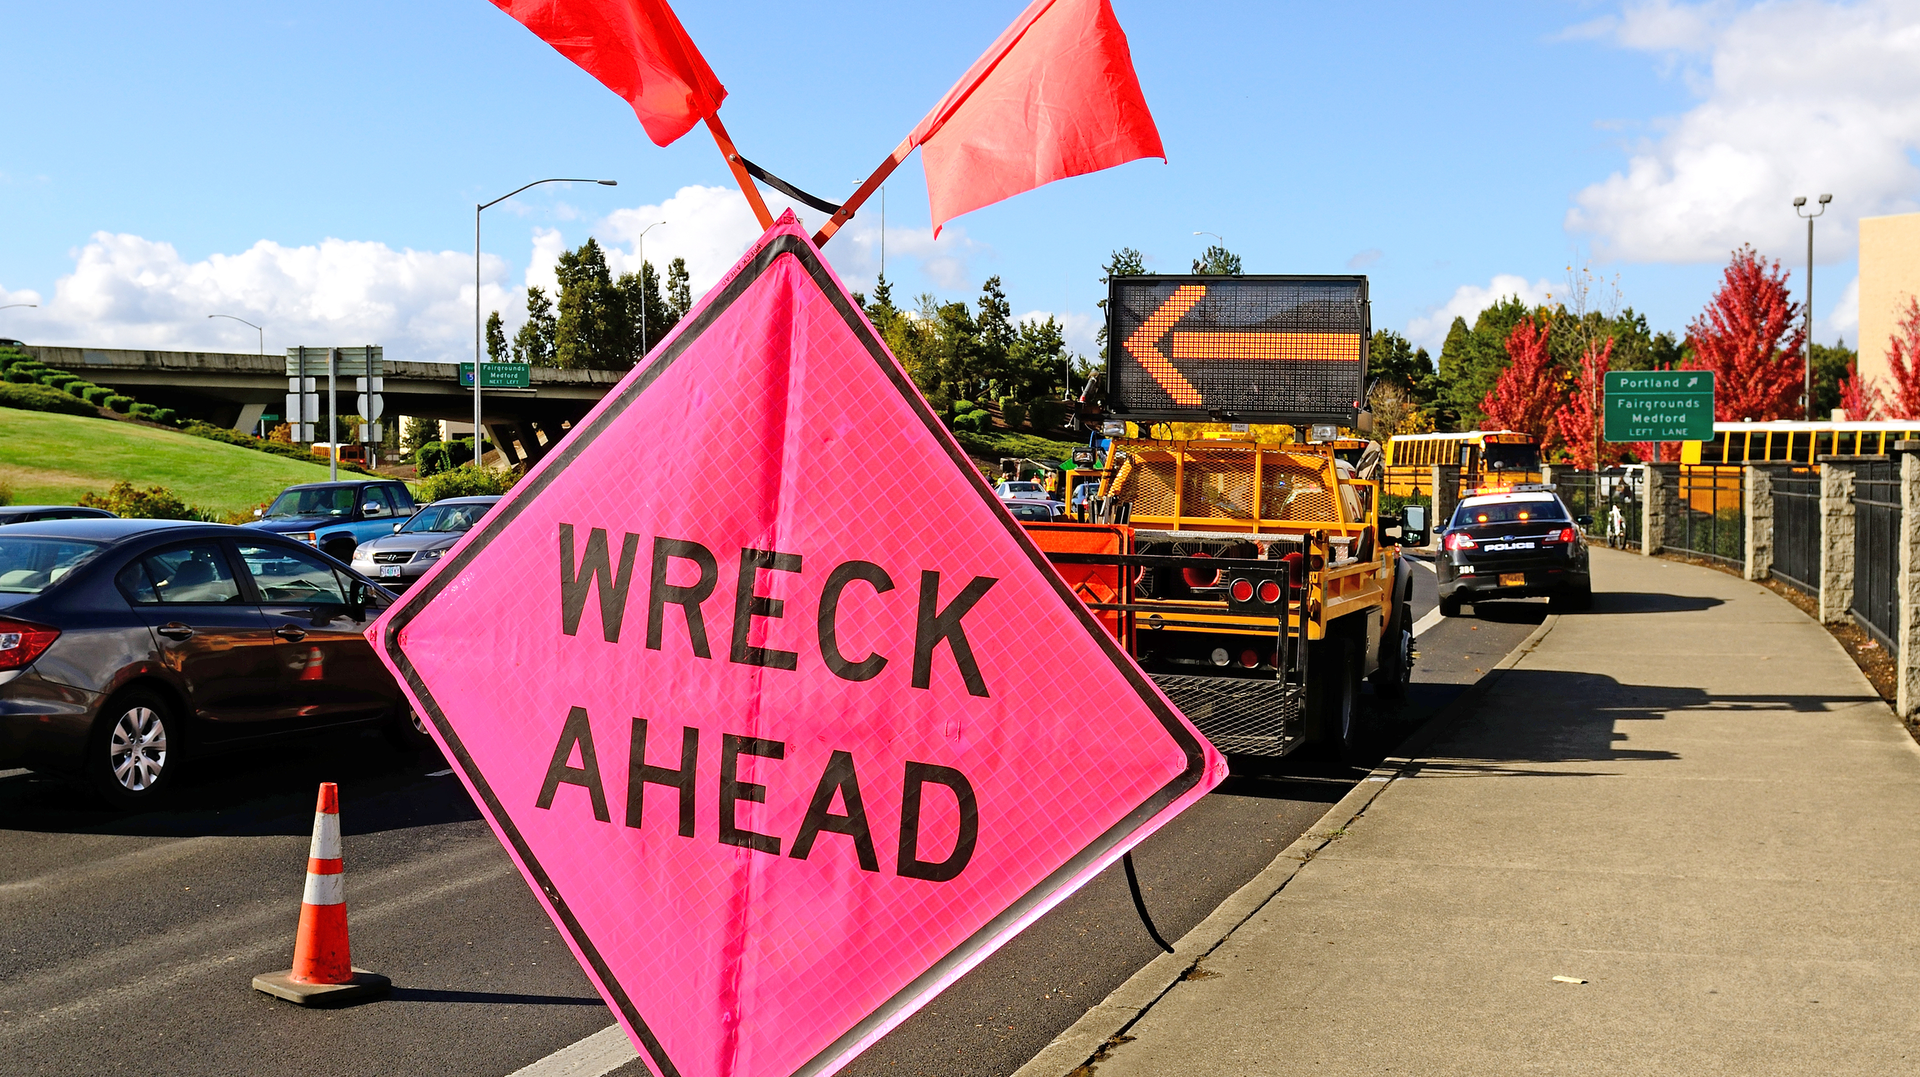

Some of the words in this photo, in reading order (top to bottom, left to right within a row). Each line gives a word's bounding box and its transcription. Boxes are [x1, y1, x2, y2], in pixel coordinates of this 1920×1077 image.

[742, 243, 763, 265] WRECK
[721, 265, 741, 286] AHEAD
[1620, 378, 1680, 388] Portland
[1617, 398, 1700, 411] Fairgrounds
[1632, 413, 1686, 423] Medford
[1629, 428, 1653, 436] LEFT
[1662, 428, 1688, 436] LANE
[1484, 541, 1535, 552] POLICE
[559, 522, 999, 698] WRECK
[535, 705, 978, 883] AHEAD
